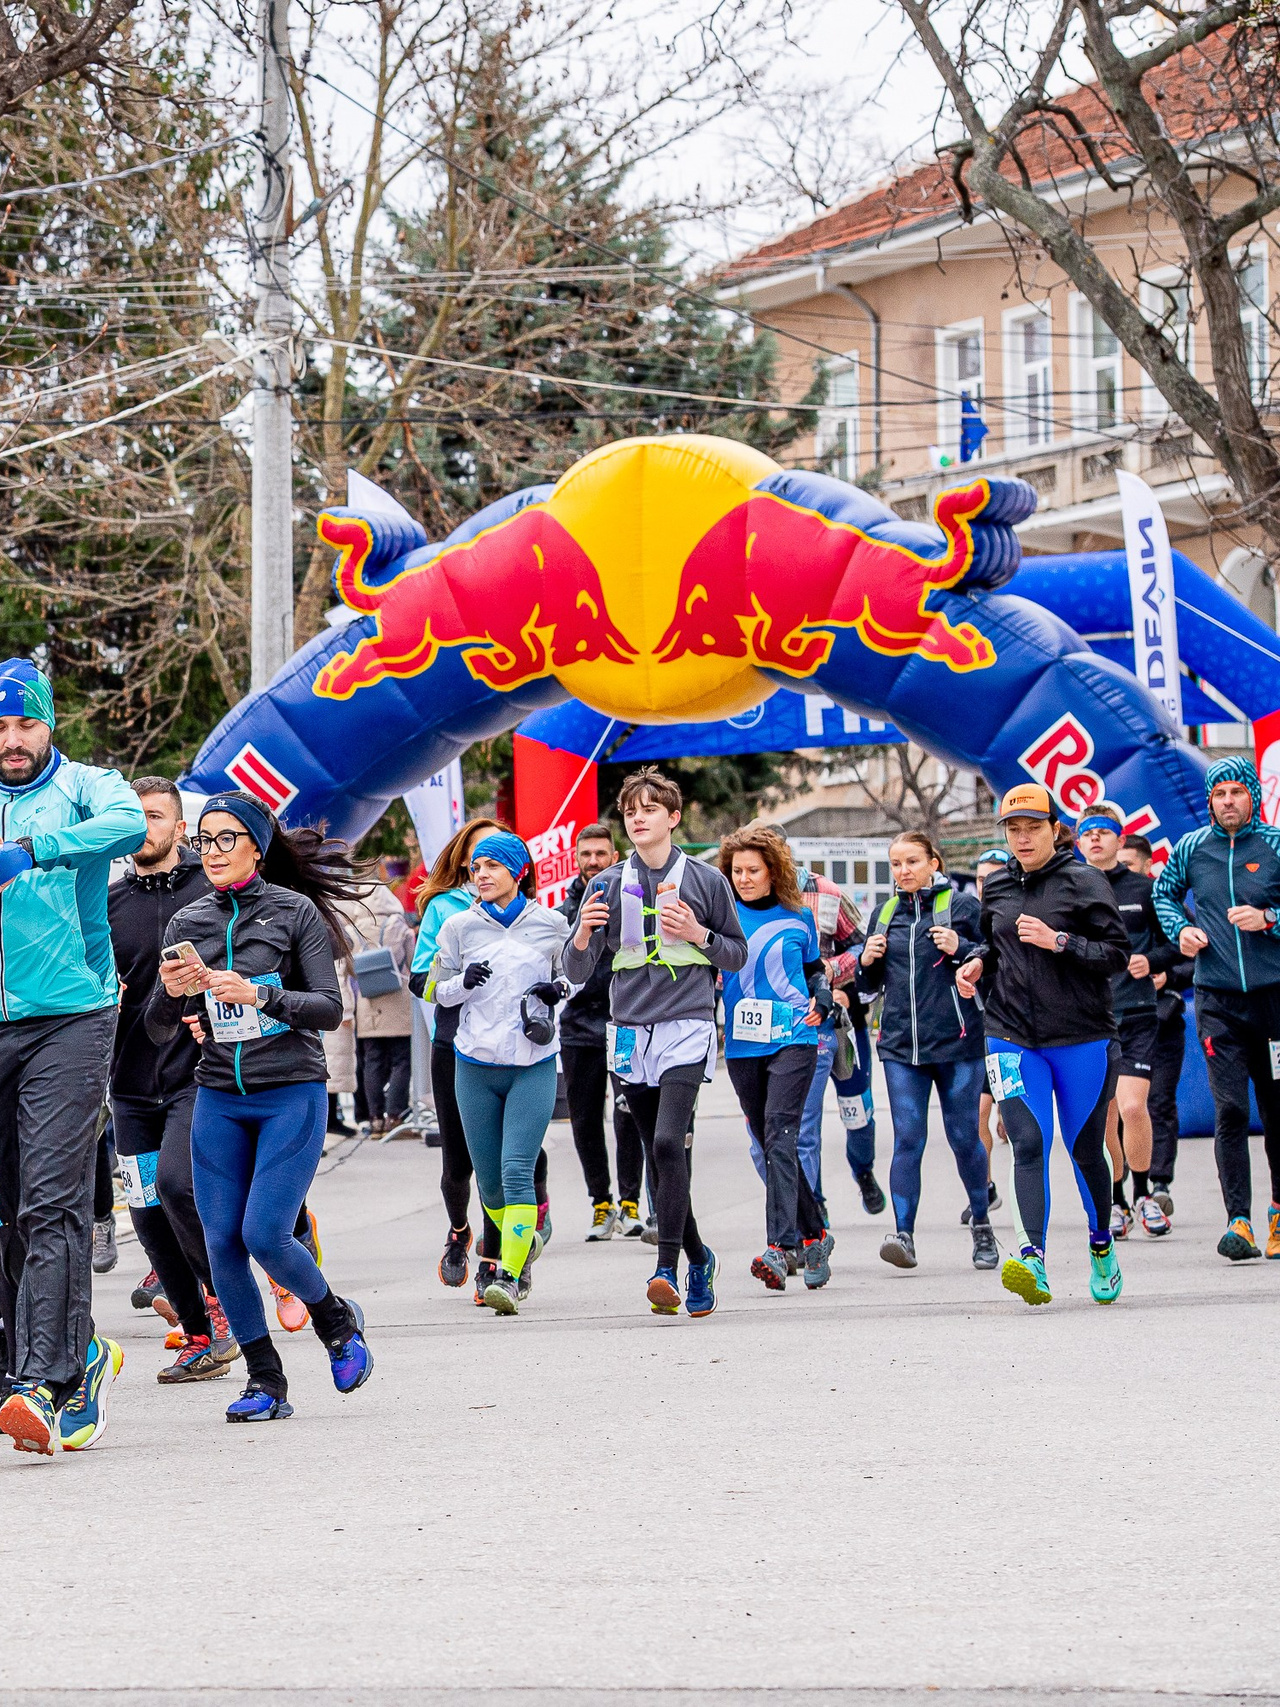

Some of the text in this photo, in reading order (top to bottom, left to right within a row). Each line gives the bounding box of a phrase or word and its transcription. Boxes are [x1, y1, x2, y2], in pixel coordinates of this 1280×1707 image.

[526, 820, 576, 863] ERY
[537, 847, 580, 887] STE
[214, 1002, 244, 1020] 180
[741, 1010, 762, 1026] 133
